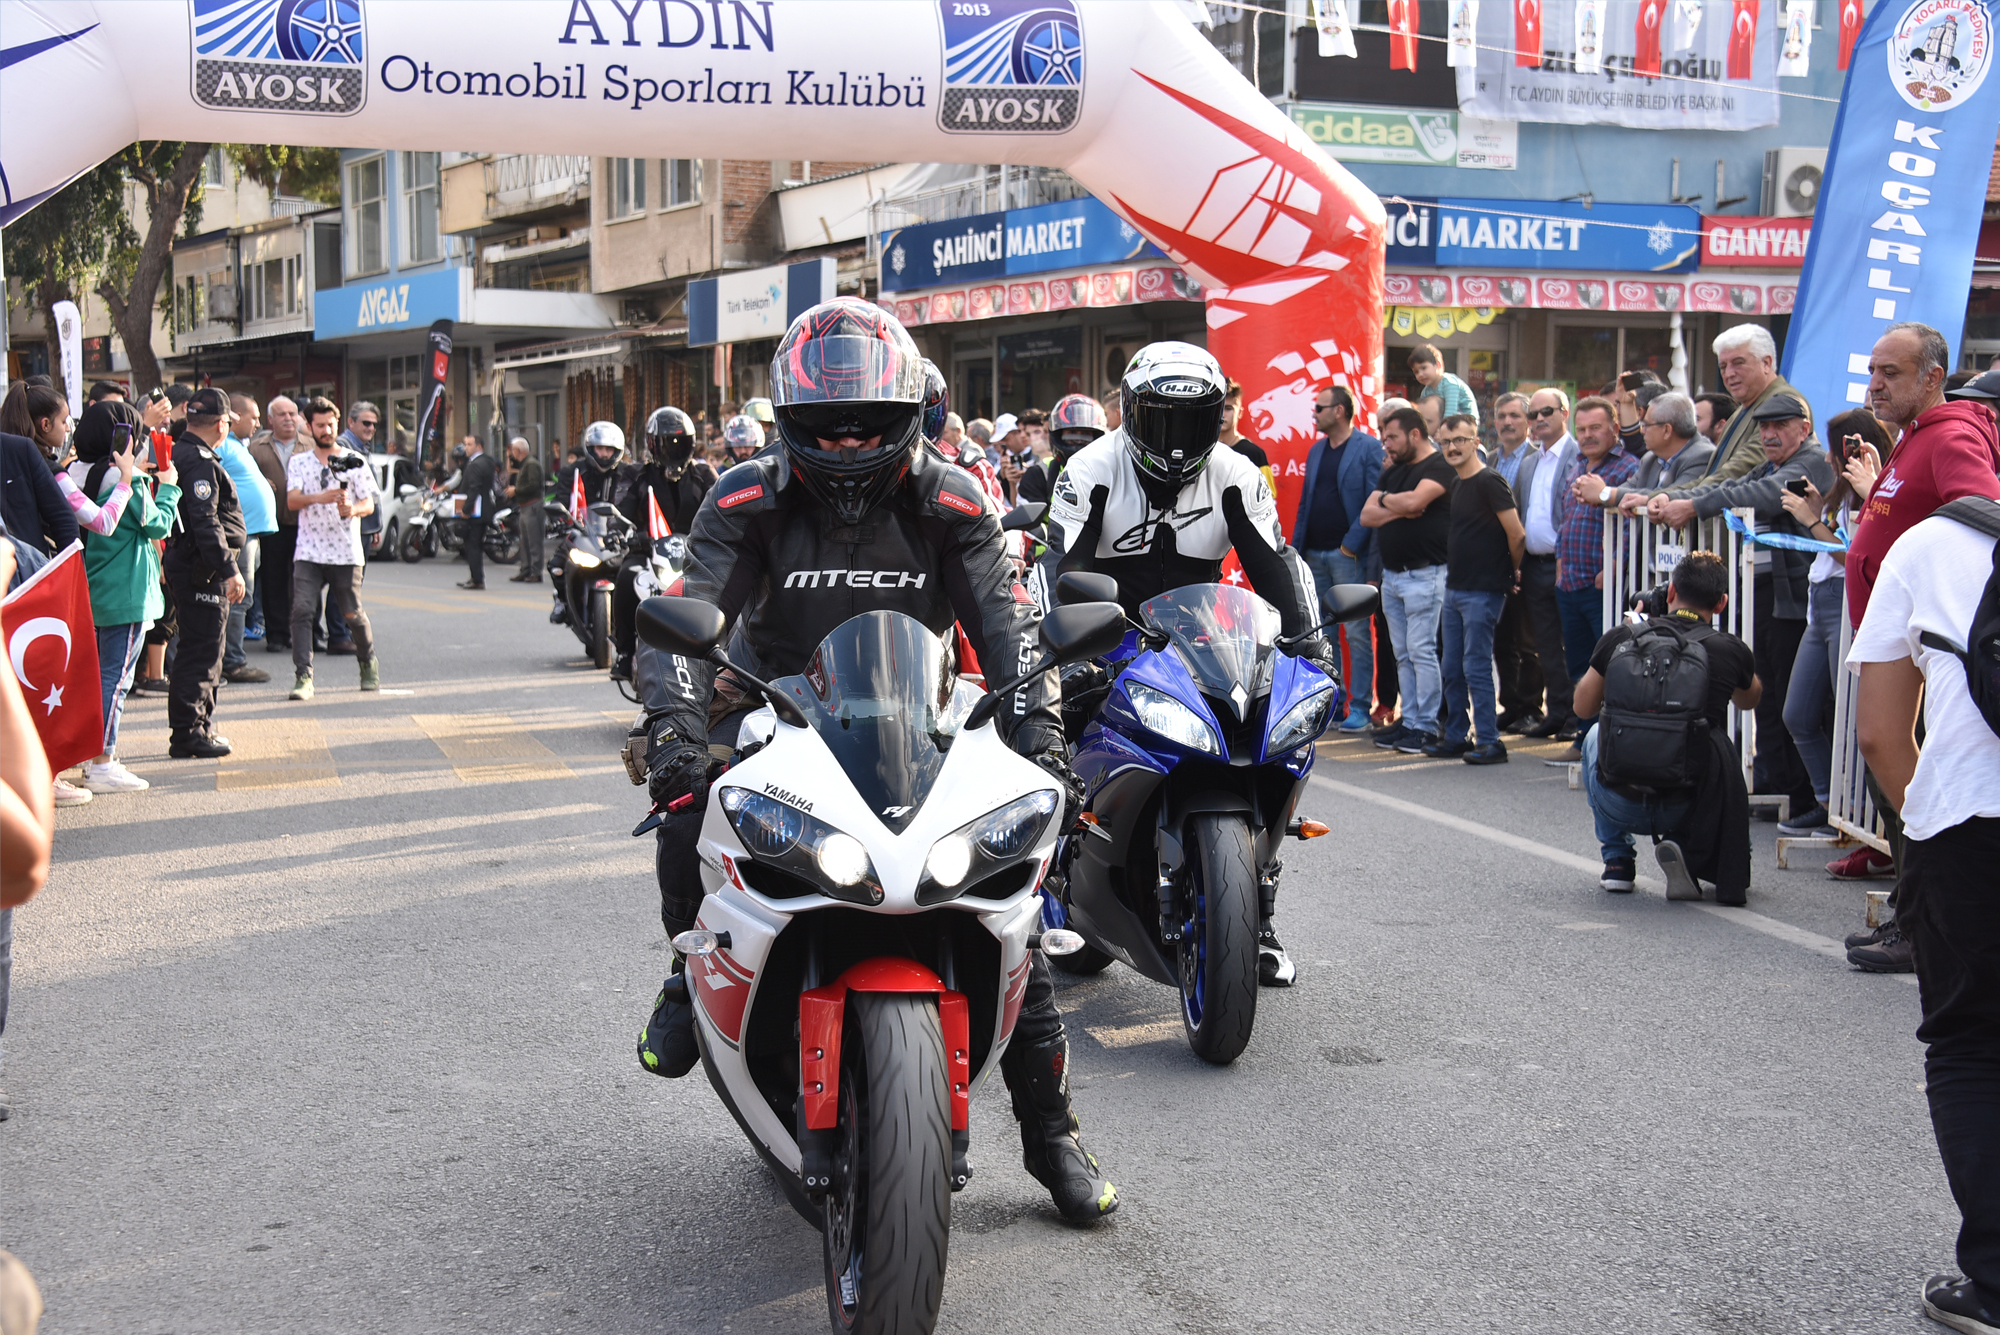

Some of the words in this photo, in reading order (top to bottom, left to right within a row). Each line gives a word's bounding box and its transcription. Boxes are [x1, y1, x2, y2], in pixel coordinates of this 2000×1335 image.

[952, 3, 991, 16] 2013
[559, 0, 774, 51] AYDIN
[212, 71, 346, 105] AYOSK
[380, 54, 587, 100] Otomobil
[603, 64, 773, 110] Sporları
[785, 69, 926, 107] Kulübü
[953, 98, 1064, 124] AYOSK
[1530, 88, 1564, 104] AYDIN
[1567, 88, 1633, 110] BÜYÜKŞEHİR
[1635, 92, 1687, 111] BELEDİYE
[1295, 113, 1415, 146] iddaa
[1438, 216, 1588, 251] MARKET
[1866, 119, 1947, 321] KOÇARLI
[933, 223, 1003, 277] ŞAHİNCİ
[1006, 216, 1086, 258] MARKET
[358, 284, 410, 327] AYGAZ
[727, 300, 742, 313] Türk
[743, 298, 771, 312] Telekom
[1164, 384, 1199, 393] HJC
[726, 489, 758, 504] MTECH
[943, 495, 974, 511] MTECH
[783, 569, 927, 589] MTECH
[1676, 608, 1699, 621] Nikon
[672, 653, 696, 700] ECH
[763, 782, 815, 813] YAMAHA
